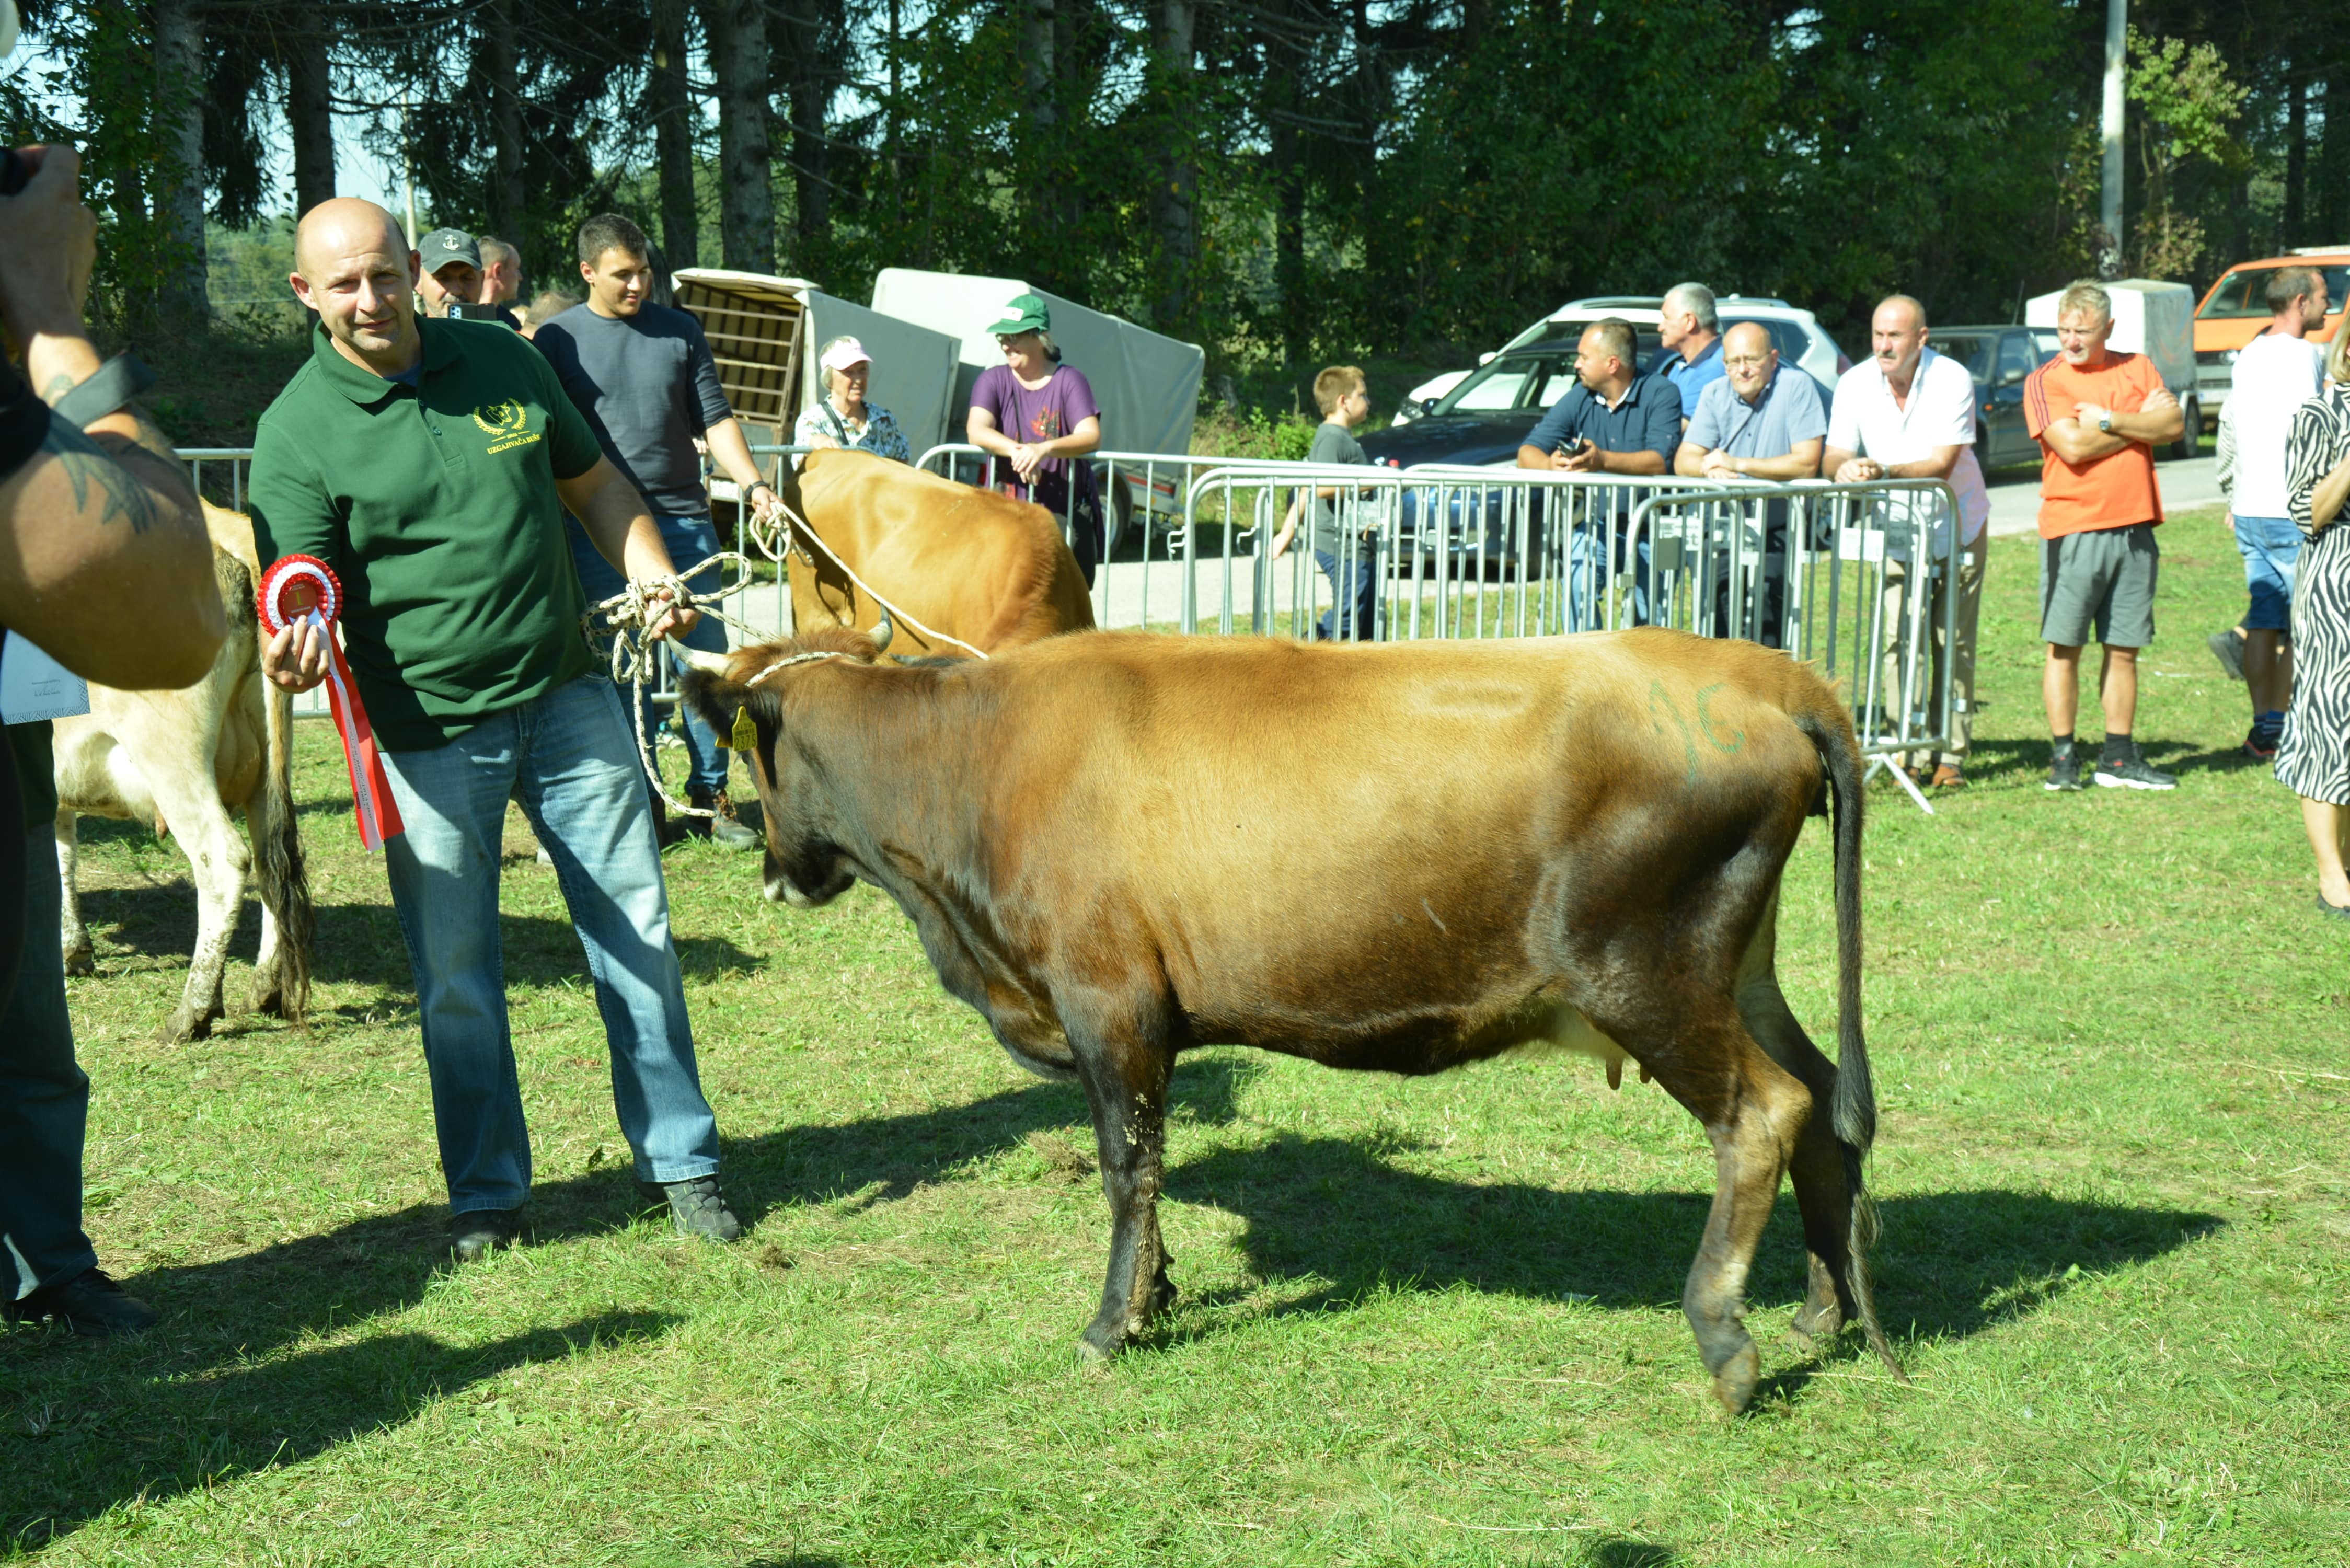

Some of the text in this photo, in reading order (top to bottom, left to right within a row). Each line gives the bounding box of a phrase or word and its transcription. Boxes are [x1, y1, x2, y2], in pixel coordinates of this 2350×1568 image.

[487, 437, 526, 454] UZGAJIVAČA
[294, 590, 305, 606] 1
[735, 734, 756, 751] 2375
